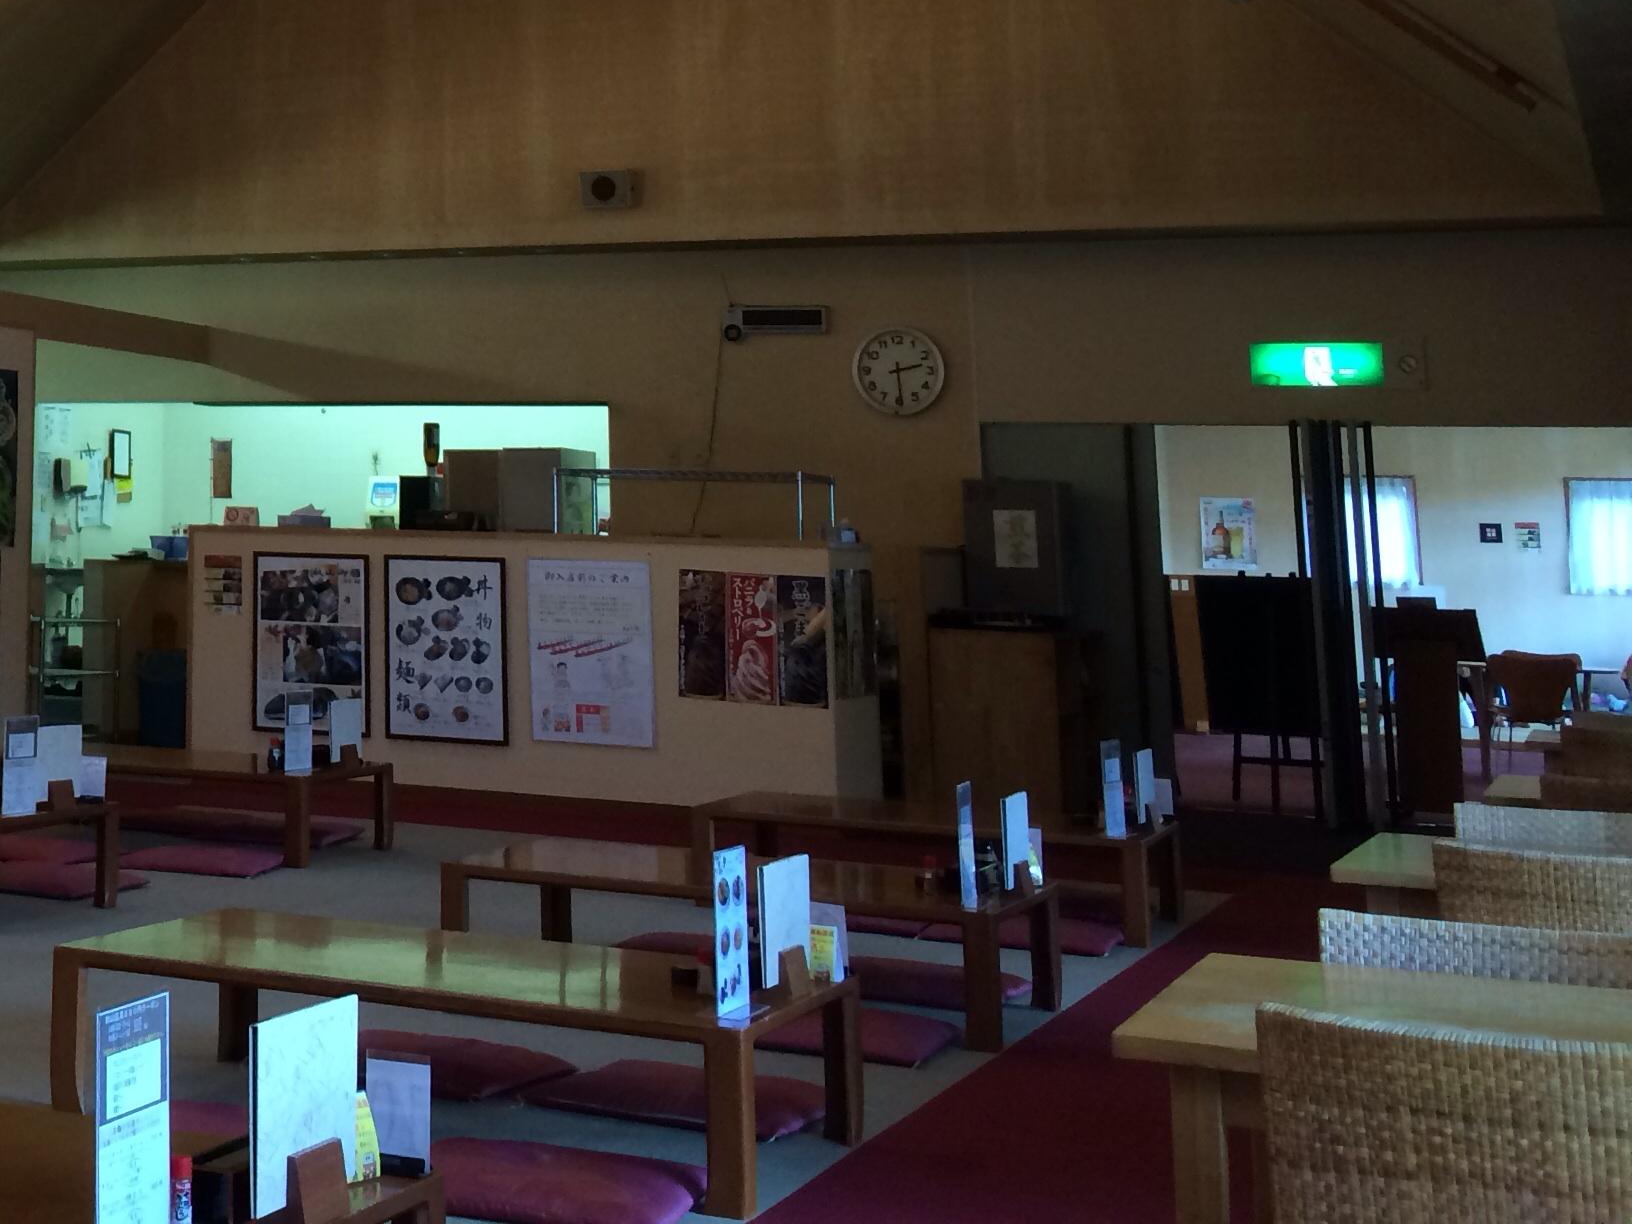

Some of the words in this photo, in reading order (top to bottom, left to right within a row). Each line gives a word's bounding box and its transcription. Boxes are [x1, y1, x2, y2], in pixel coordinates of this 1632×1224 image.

[878, 340, 888, 349] 11
[891, 336, 904, 345] 12
[920, 350, 929, 361] 2
[926, 366, 935, 376] 3
[880, 391, 888, 401] 7
[911, 391, 920, 402] 5
